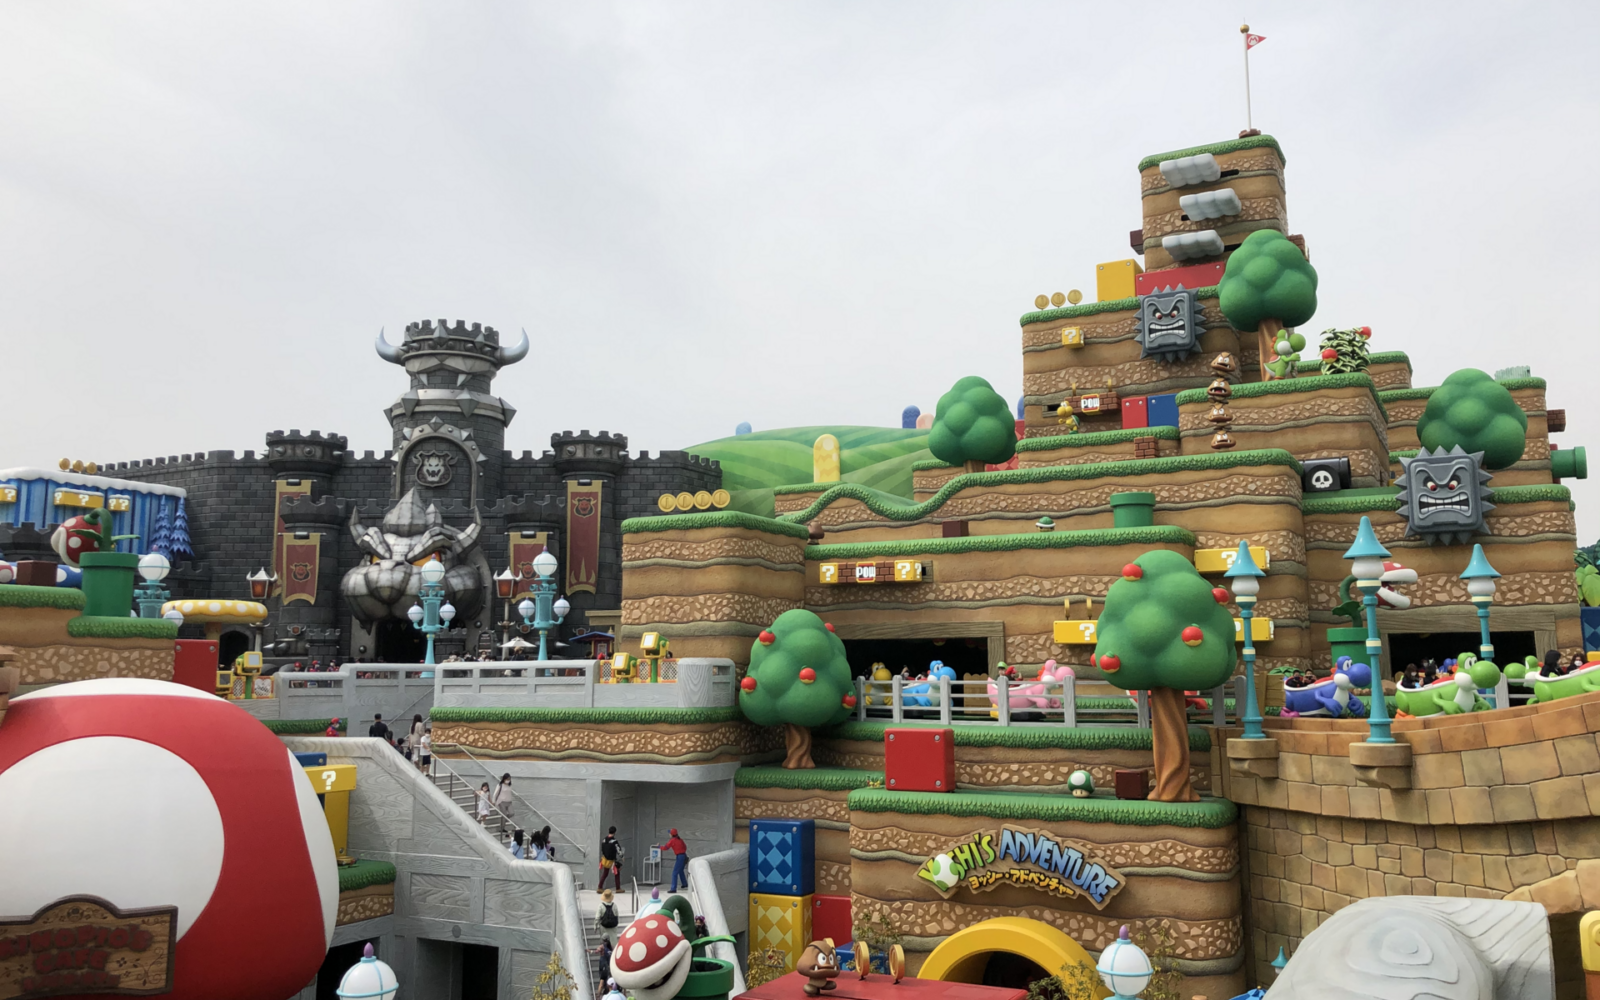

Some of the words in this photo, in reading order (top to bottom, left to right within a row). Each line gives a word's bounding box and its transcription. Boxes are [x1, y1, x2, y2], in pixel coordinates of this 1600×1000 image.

[1081, 397, 1100, 409] POW
[856, 566, 876, 578] POW
[999, 828, 1120, 904] ADVENTURE
[34, 948, 109, 973] CAFE
